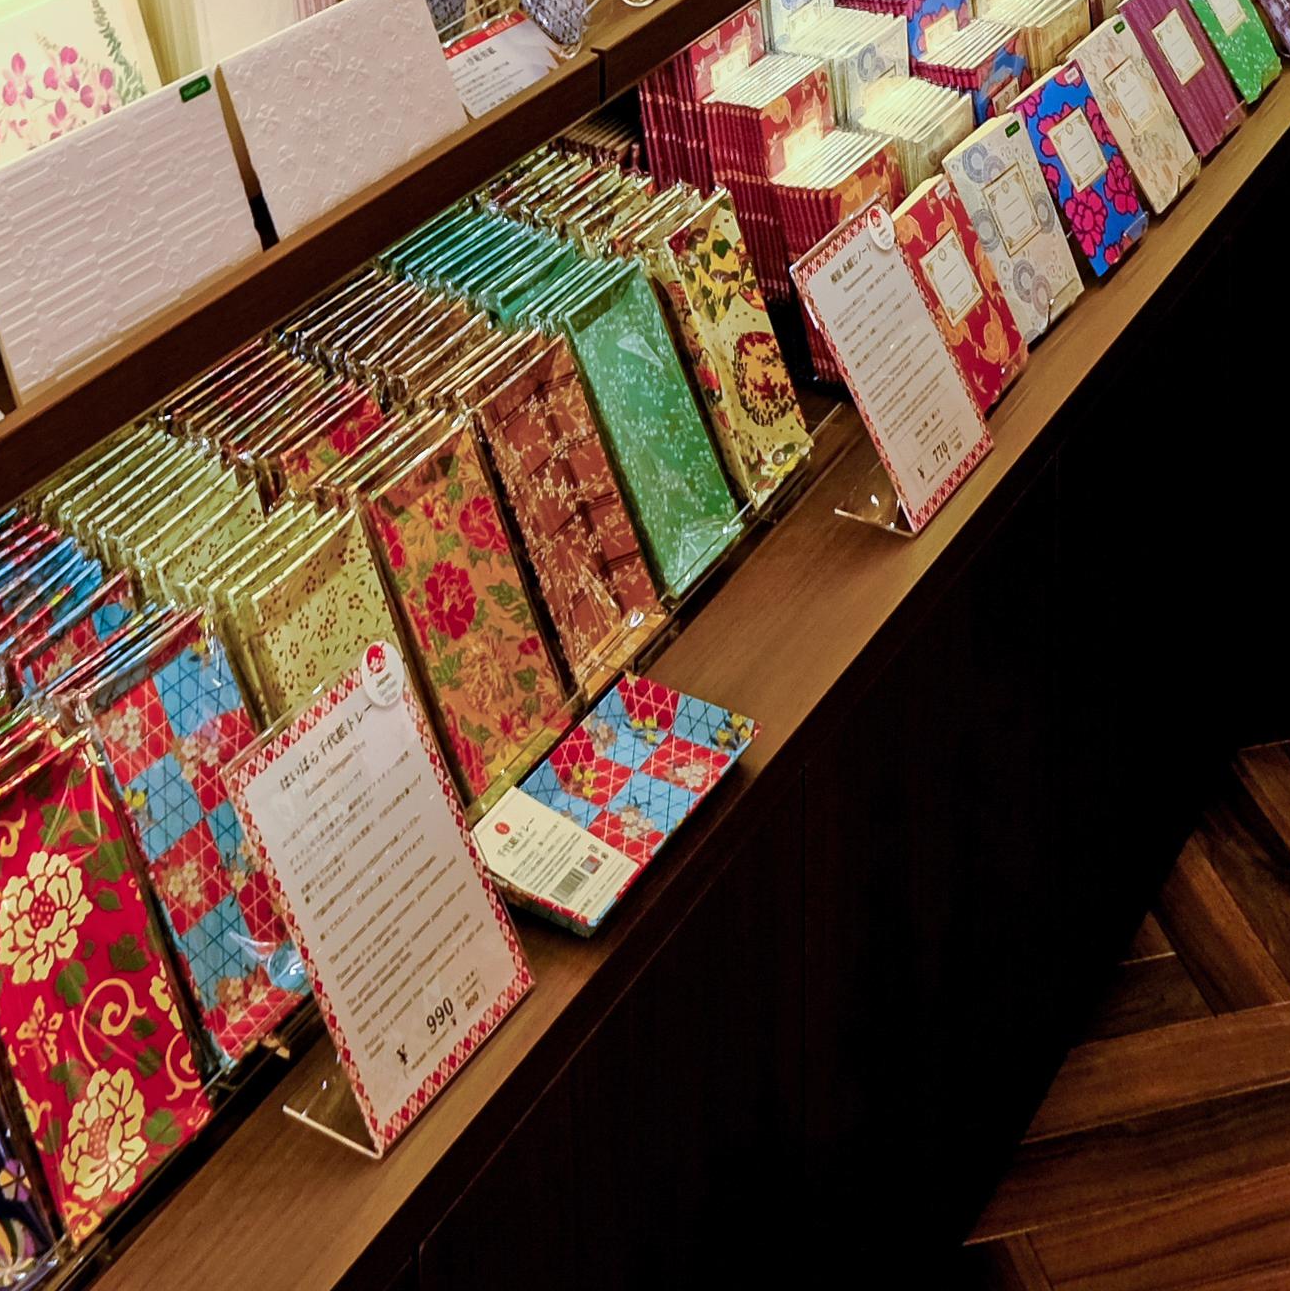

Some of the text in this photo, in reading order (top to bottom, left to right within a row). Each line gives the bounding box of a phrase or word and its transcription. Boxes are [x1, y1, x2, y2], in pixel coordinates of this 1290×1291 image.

[932, 441, 949, 462] 770
[279, 751, 319, 791] はいばら
[396, 997, 454, 1065] ¥ 990
